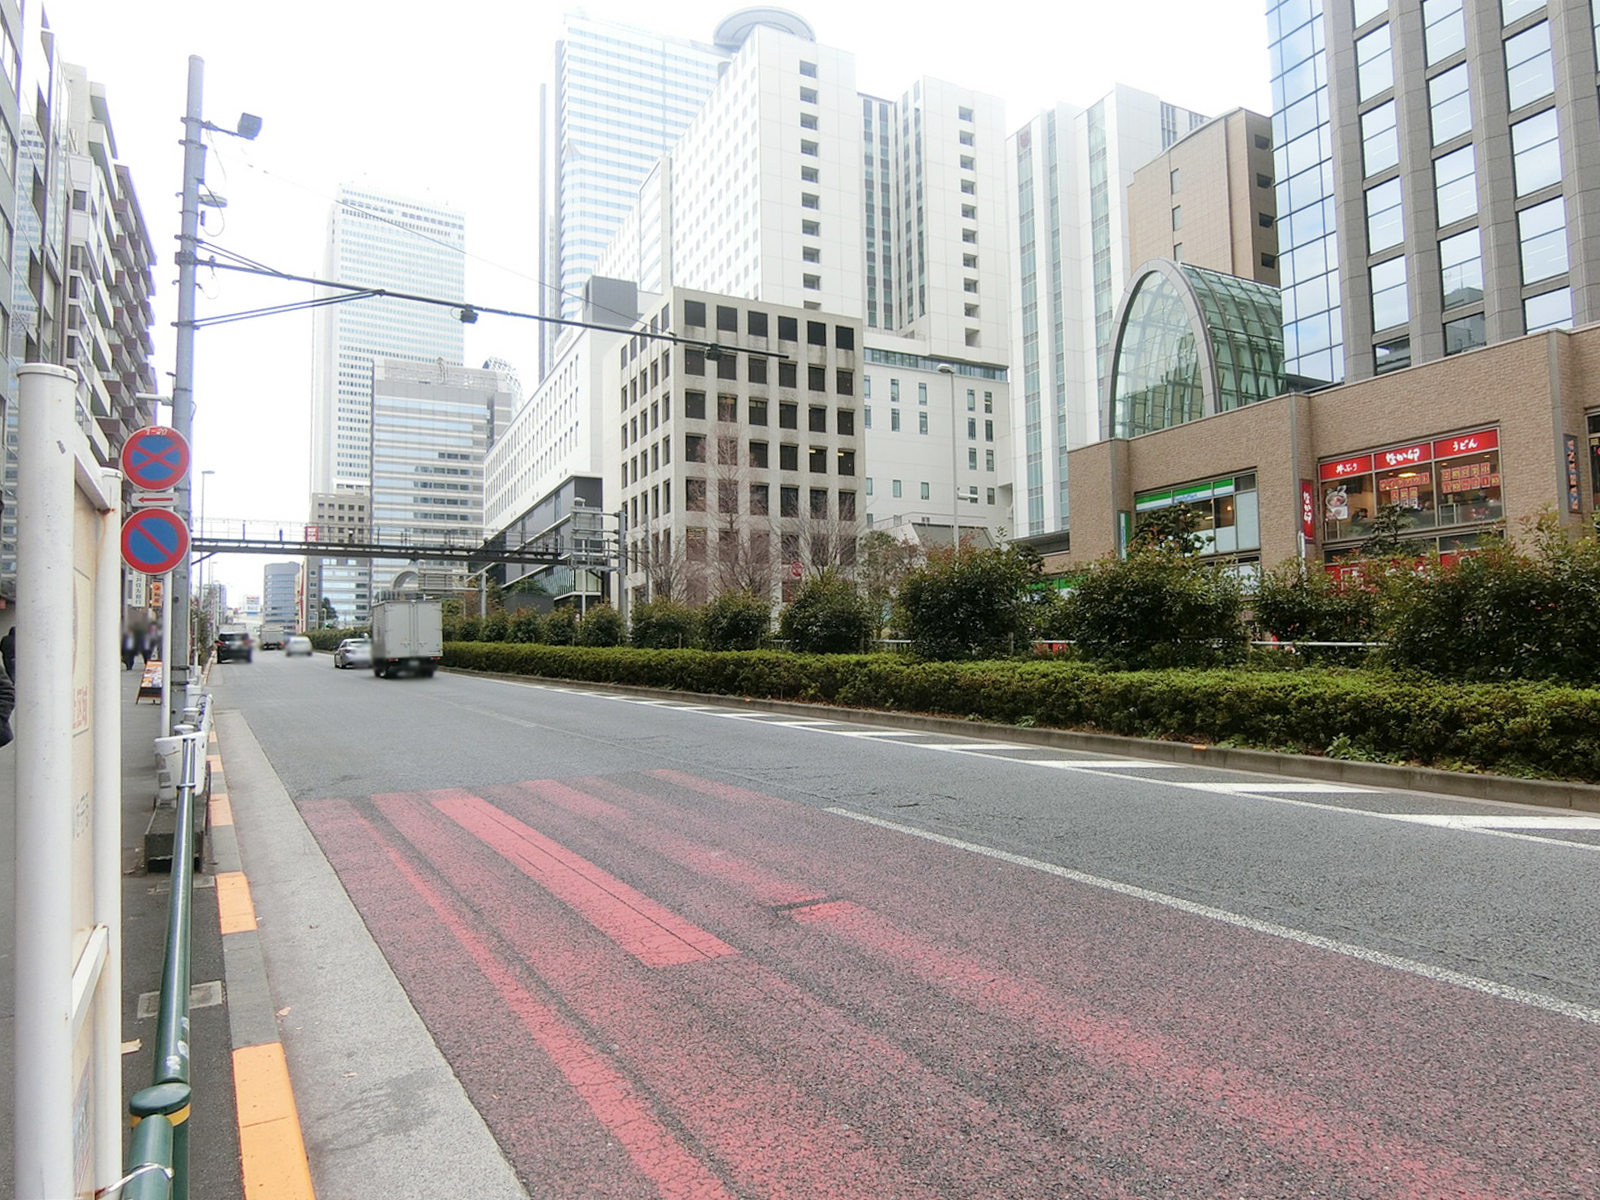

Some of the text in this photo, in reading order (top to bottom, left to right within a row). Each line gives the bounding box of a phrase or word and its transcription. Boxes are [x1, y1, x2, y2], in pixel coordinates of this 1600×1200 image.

[1453, 438, 1478, 452] うどん
[1385, 448, 1420, 465] なか卯
[1303, 491, 1312, 524] なか卯
